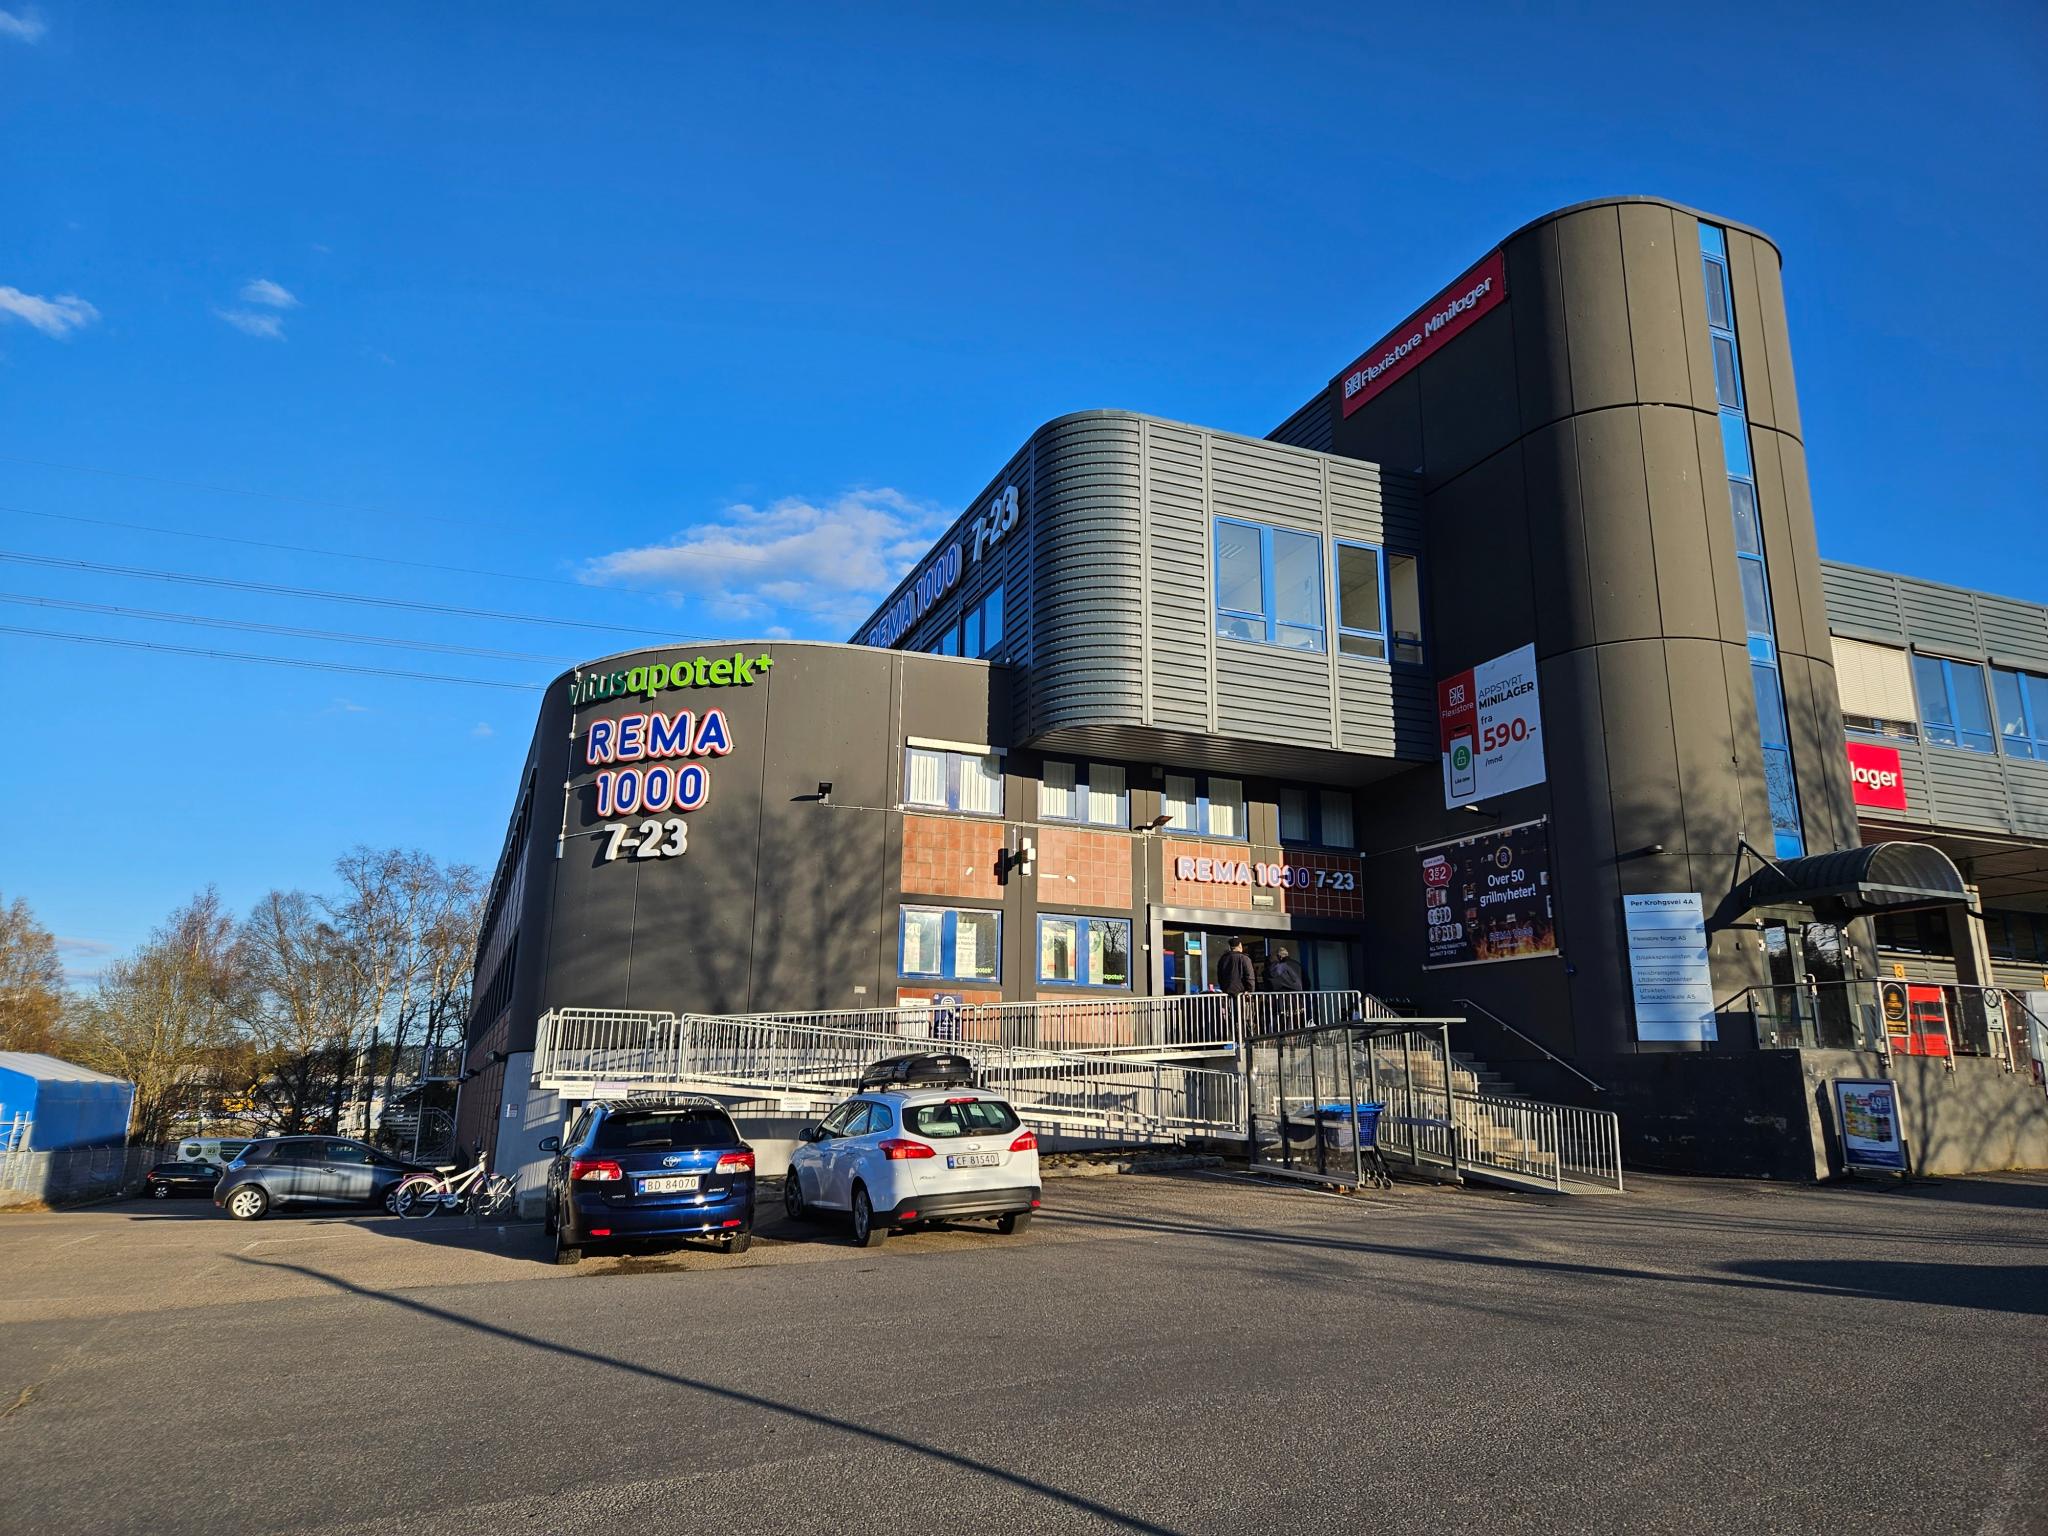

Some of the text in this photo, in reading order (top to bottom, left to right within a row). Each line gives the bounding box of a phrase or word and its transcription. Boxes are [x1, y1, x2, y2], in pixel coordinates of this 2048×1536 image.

[1361, 277, 1492, 387] Flexistore Minilager
[868, 485, 1019, 649] REMA 1000 7-23
[1479, 674, 1523, 699] APPSTYRT
[1479, 681, 1535, 710] MINILAGER
[1441, 702, 1474, 718] Flexistore
[1481, 713, 1494, 726] fra
[586, 707, 733, 765] REMA
[1485, 755, 1503, 767] /mnd
[597, 762, 709, 816] 1000
[1850, 761, 1897, 790] lager
[604, 818, 688, 861] 7-23
[1176, 855, 1355, 891] REMA 1000 7-23
[1487, 868, 1526, 888] Over 50
[1479, 883, 1537, 908] grillnyheter!
[956, 1155, 996, 1165] CF 81540
[647, 1178, 697, 1191] BD 84070
